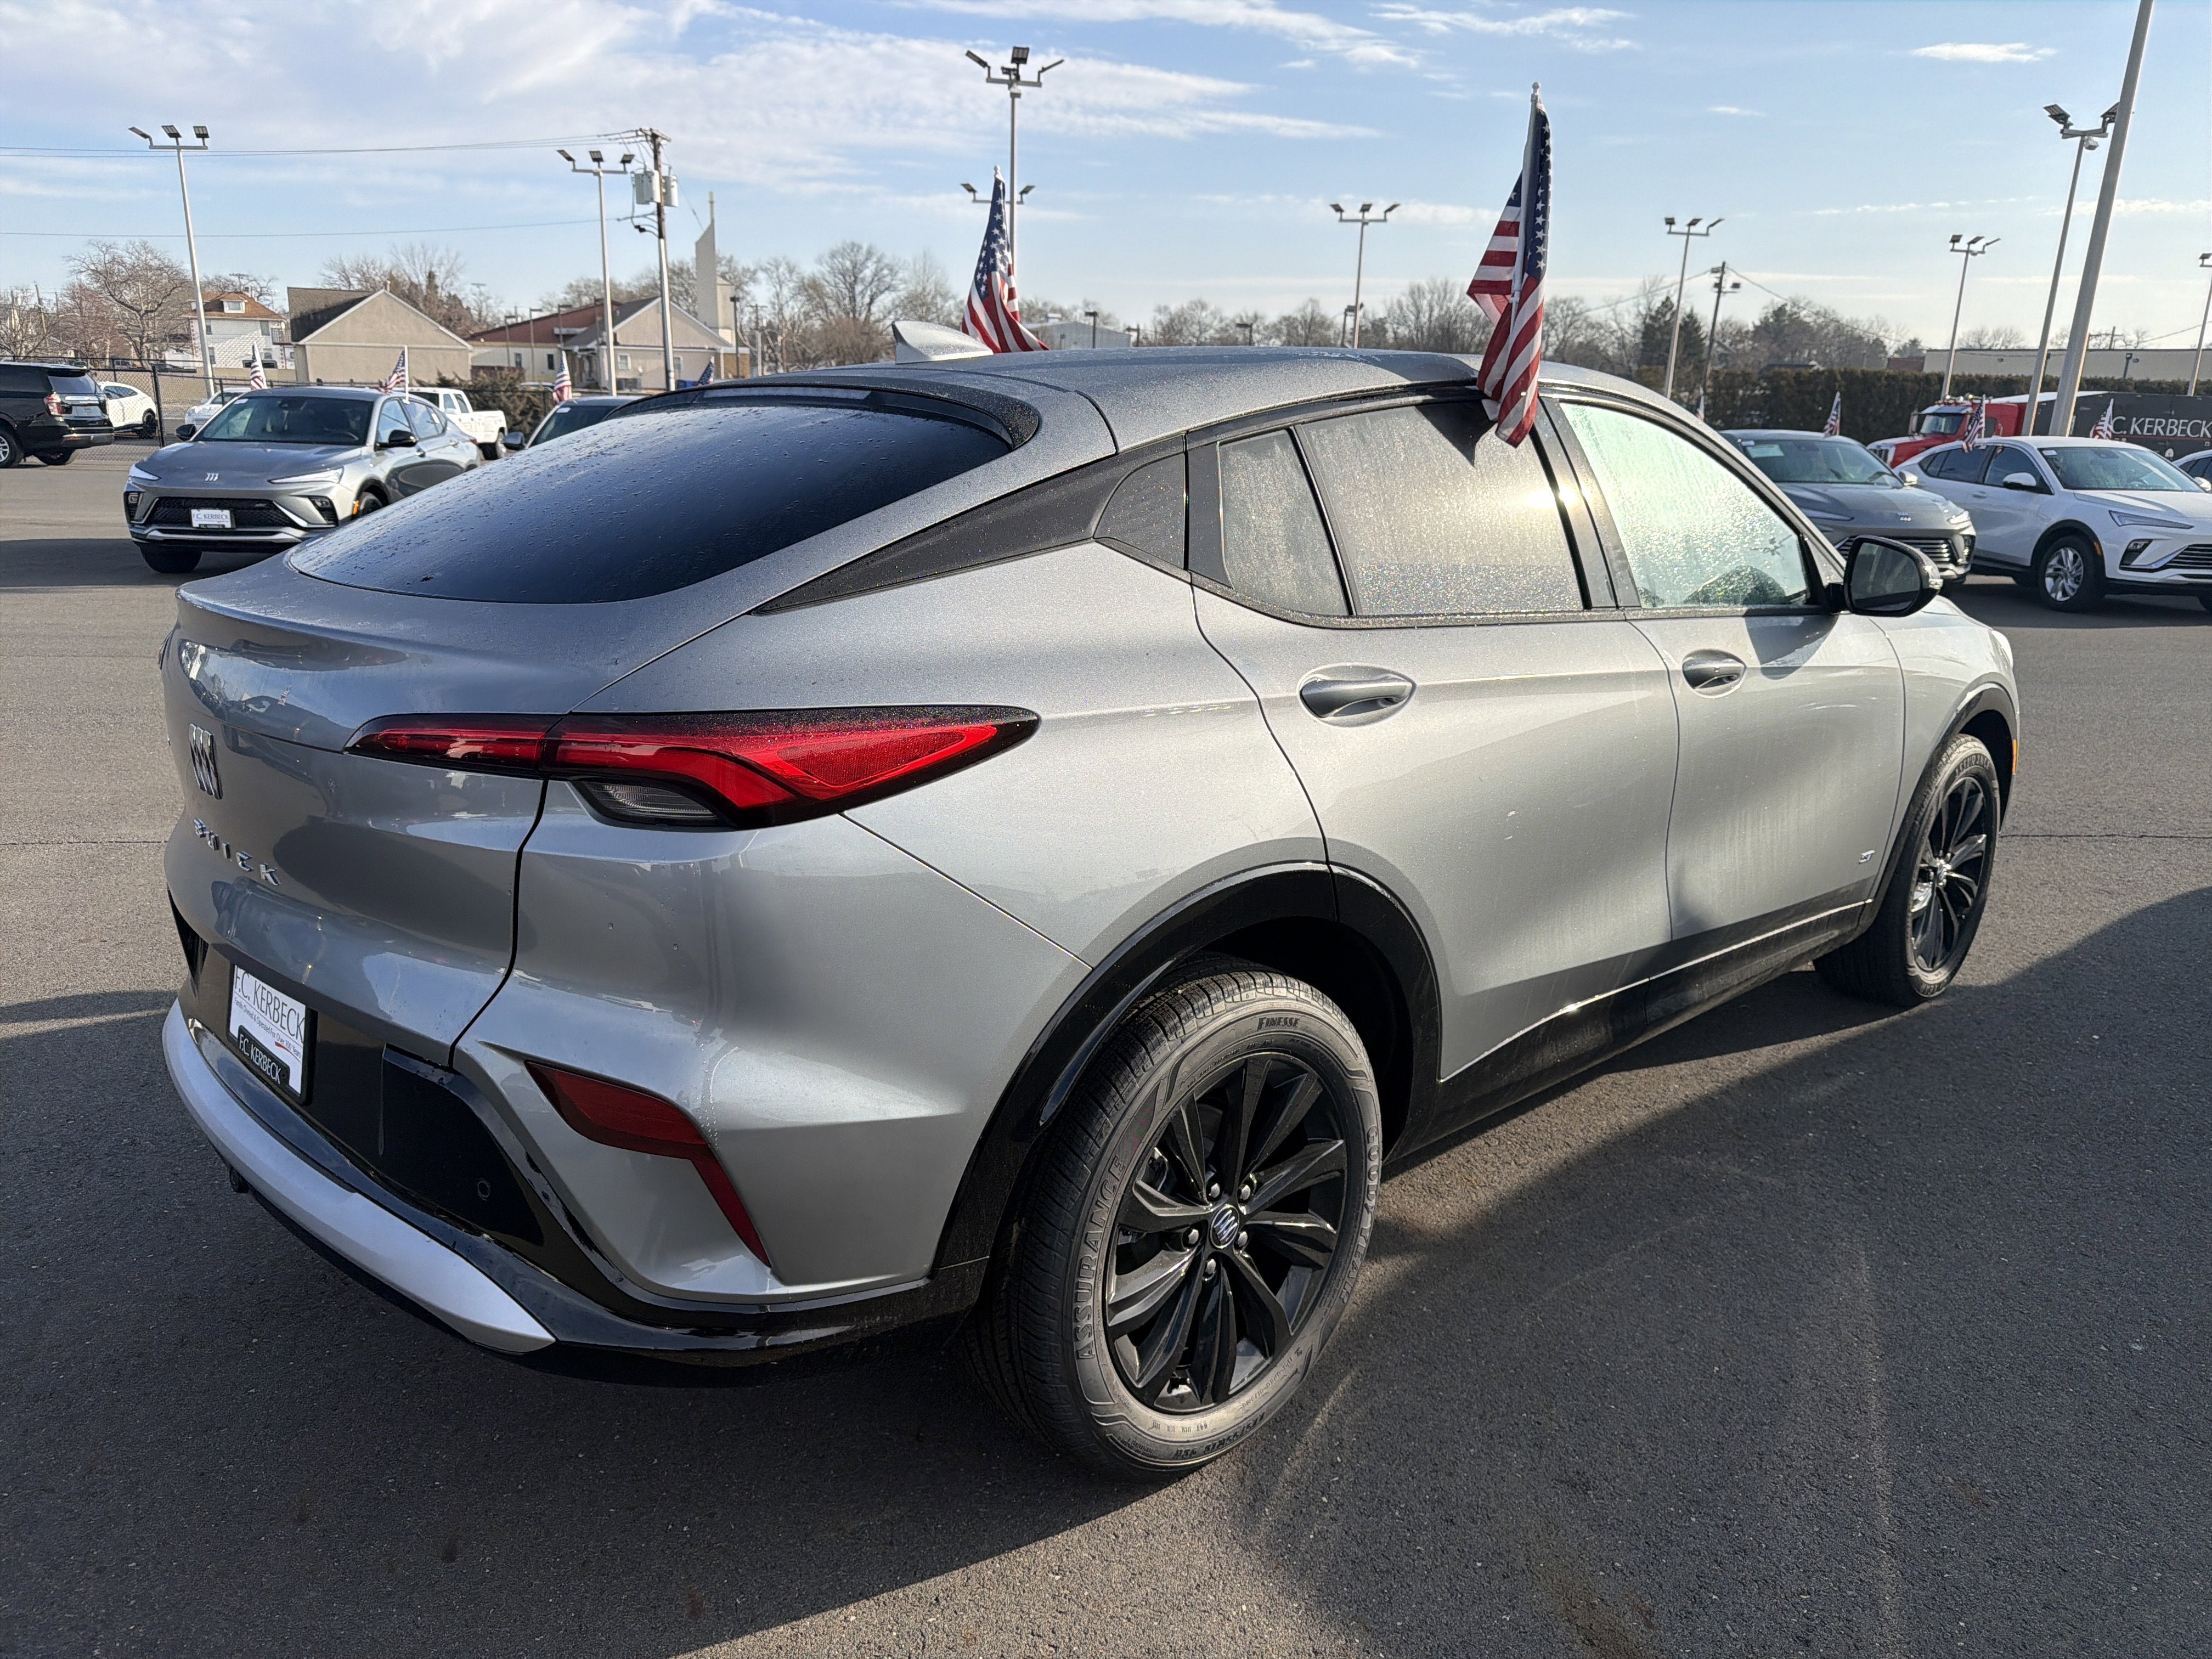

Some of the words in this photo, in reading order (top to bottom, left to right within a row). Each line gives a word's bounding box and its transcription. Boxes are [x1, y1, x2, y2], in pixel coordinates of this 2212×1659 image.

[2129, 417, 2212, 438] KERBECK
[194, 817, 280, 885] BUICK
[253, 980, 305, 1043] KERBECK
[1256, 1017, 1300, 1031] FINESSE
[250, 1043, 281, 1084] KERBECK
[276, 1033, 284, 1045] Over
[1339, 1126, 1378, 1304] GOODYEAR
[1075, 1155, 1126, 1359] ASSURANCE
